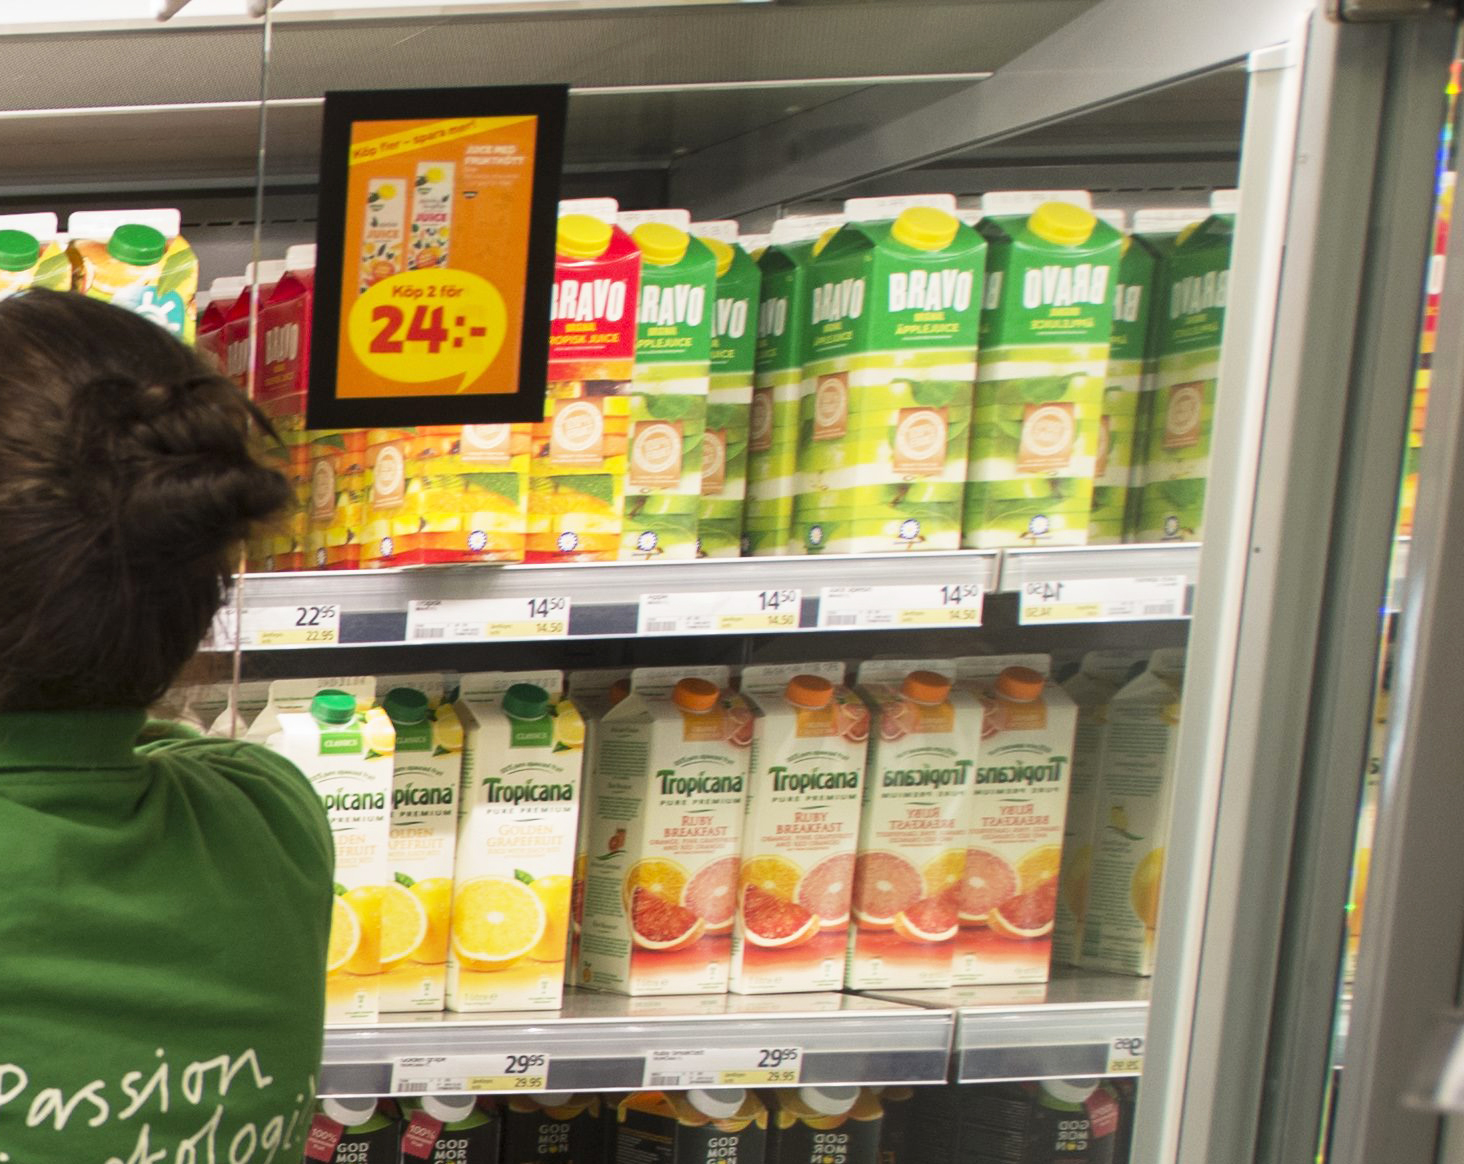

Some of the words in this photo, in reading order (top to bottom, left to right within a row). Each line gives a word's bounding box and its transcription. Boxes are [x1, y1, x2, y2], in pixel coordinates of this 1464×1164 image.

[391, 286, 424, 301] Köp
[427, 286, 436, 297] 2
[439, 285, 465, 298] för
[888, 269, 973, 313] BRAVO
[812, 276, 866, 326] BRAVO
[369, 304, 487, 354] 24:-
[656, 768, 744, 797] Tropicana
[768, 765, 859, 793] Tropicana
[481, 776, 574, 804] Tropicana
[681, 815, 713, 827] RUBY
[794, 812, 827, 824] RUBY
[499, 824, 553, 837] GOLDEN
[663, 825, 728, 838] BREAKFAST
[775, 822, 844, 835] BREAKFAST
[486, 834, 564, 848] GRAPEFRUIT
[514, 1077, 543, 1088] 29.95
[336, 1142, 370, 1153] GOD
[435, 1140, 468, 1150] GOD
[708, 1137, 739, 1147] GOD
[335, 1152, 368, 1163] MOR
[434, 1149, 467, 1160] MOR
[707, 1147, 738, 1157] MOR
